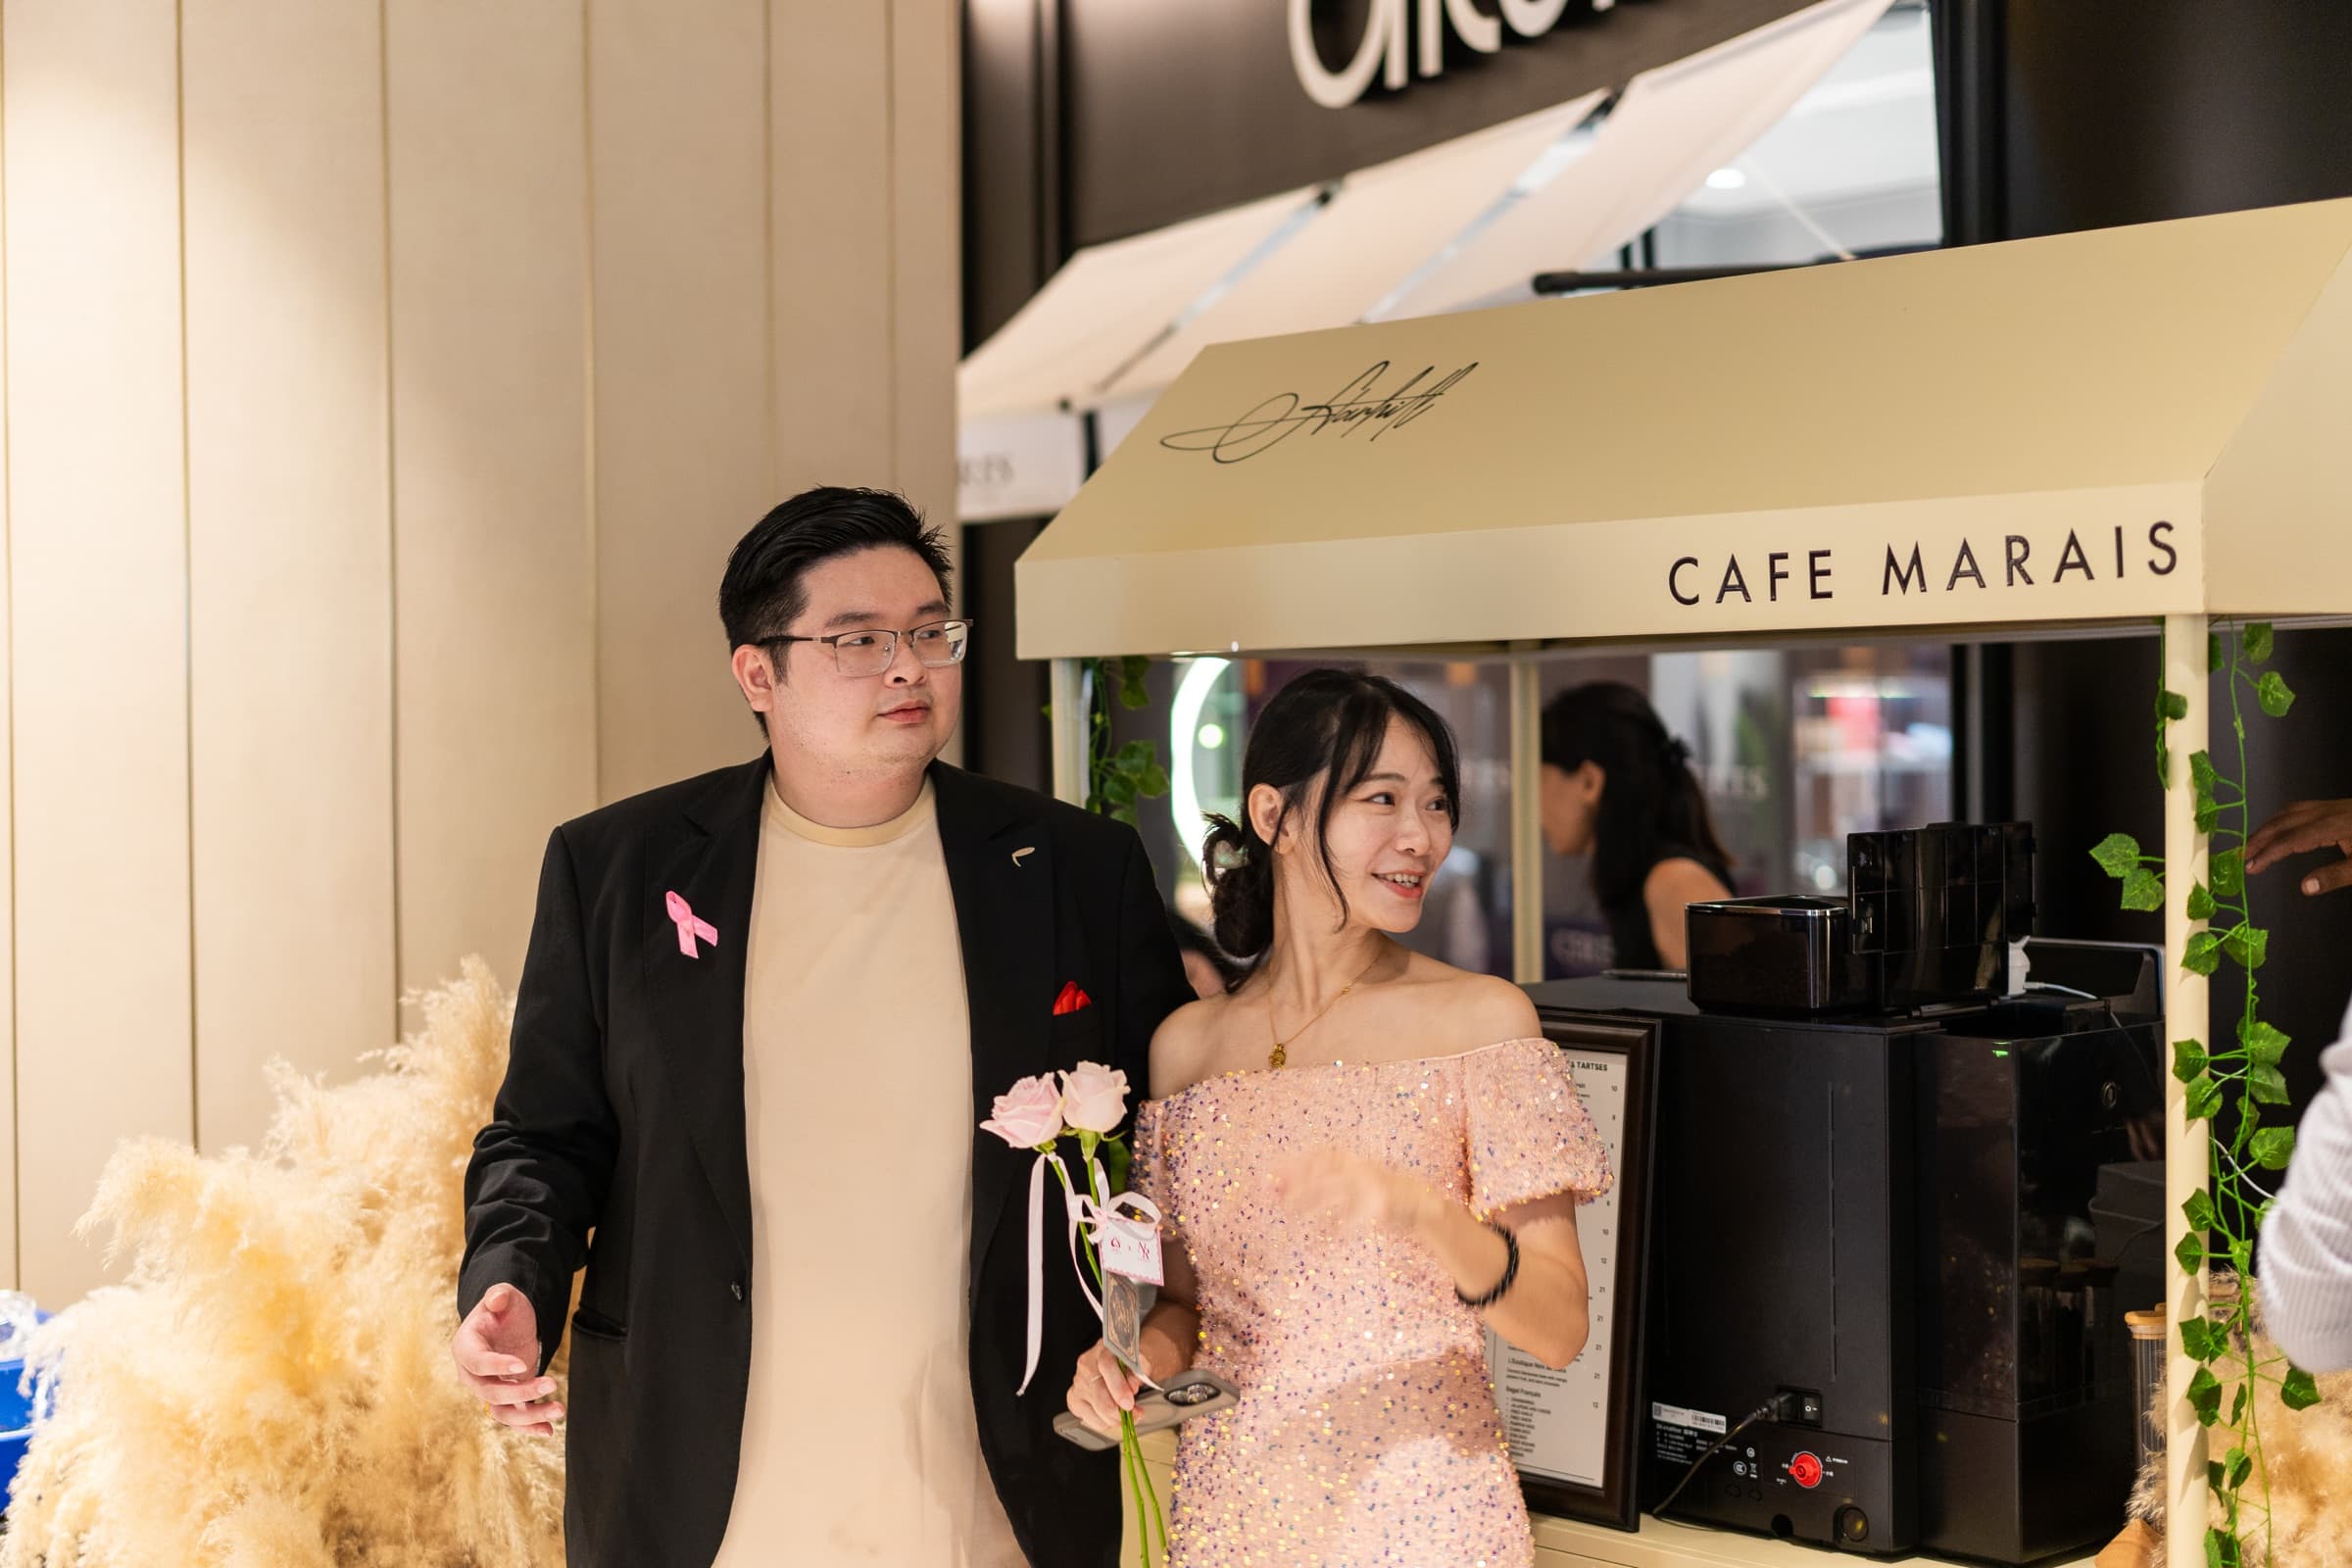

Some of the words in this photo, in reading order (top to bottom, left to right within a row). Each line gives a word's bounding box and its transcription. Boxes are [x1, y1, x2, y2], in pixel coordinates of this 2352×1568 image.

[1668, 550, 1834, 607] CAFE
[1882, 520, 2178, 596] MARAIS
[1577, 1061, 1608, 1071] TARTSES
